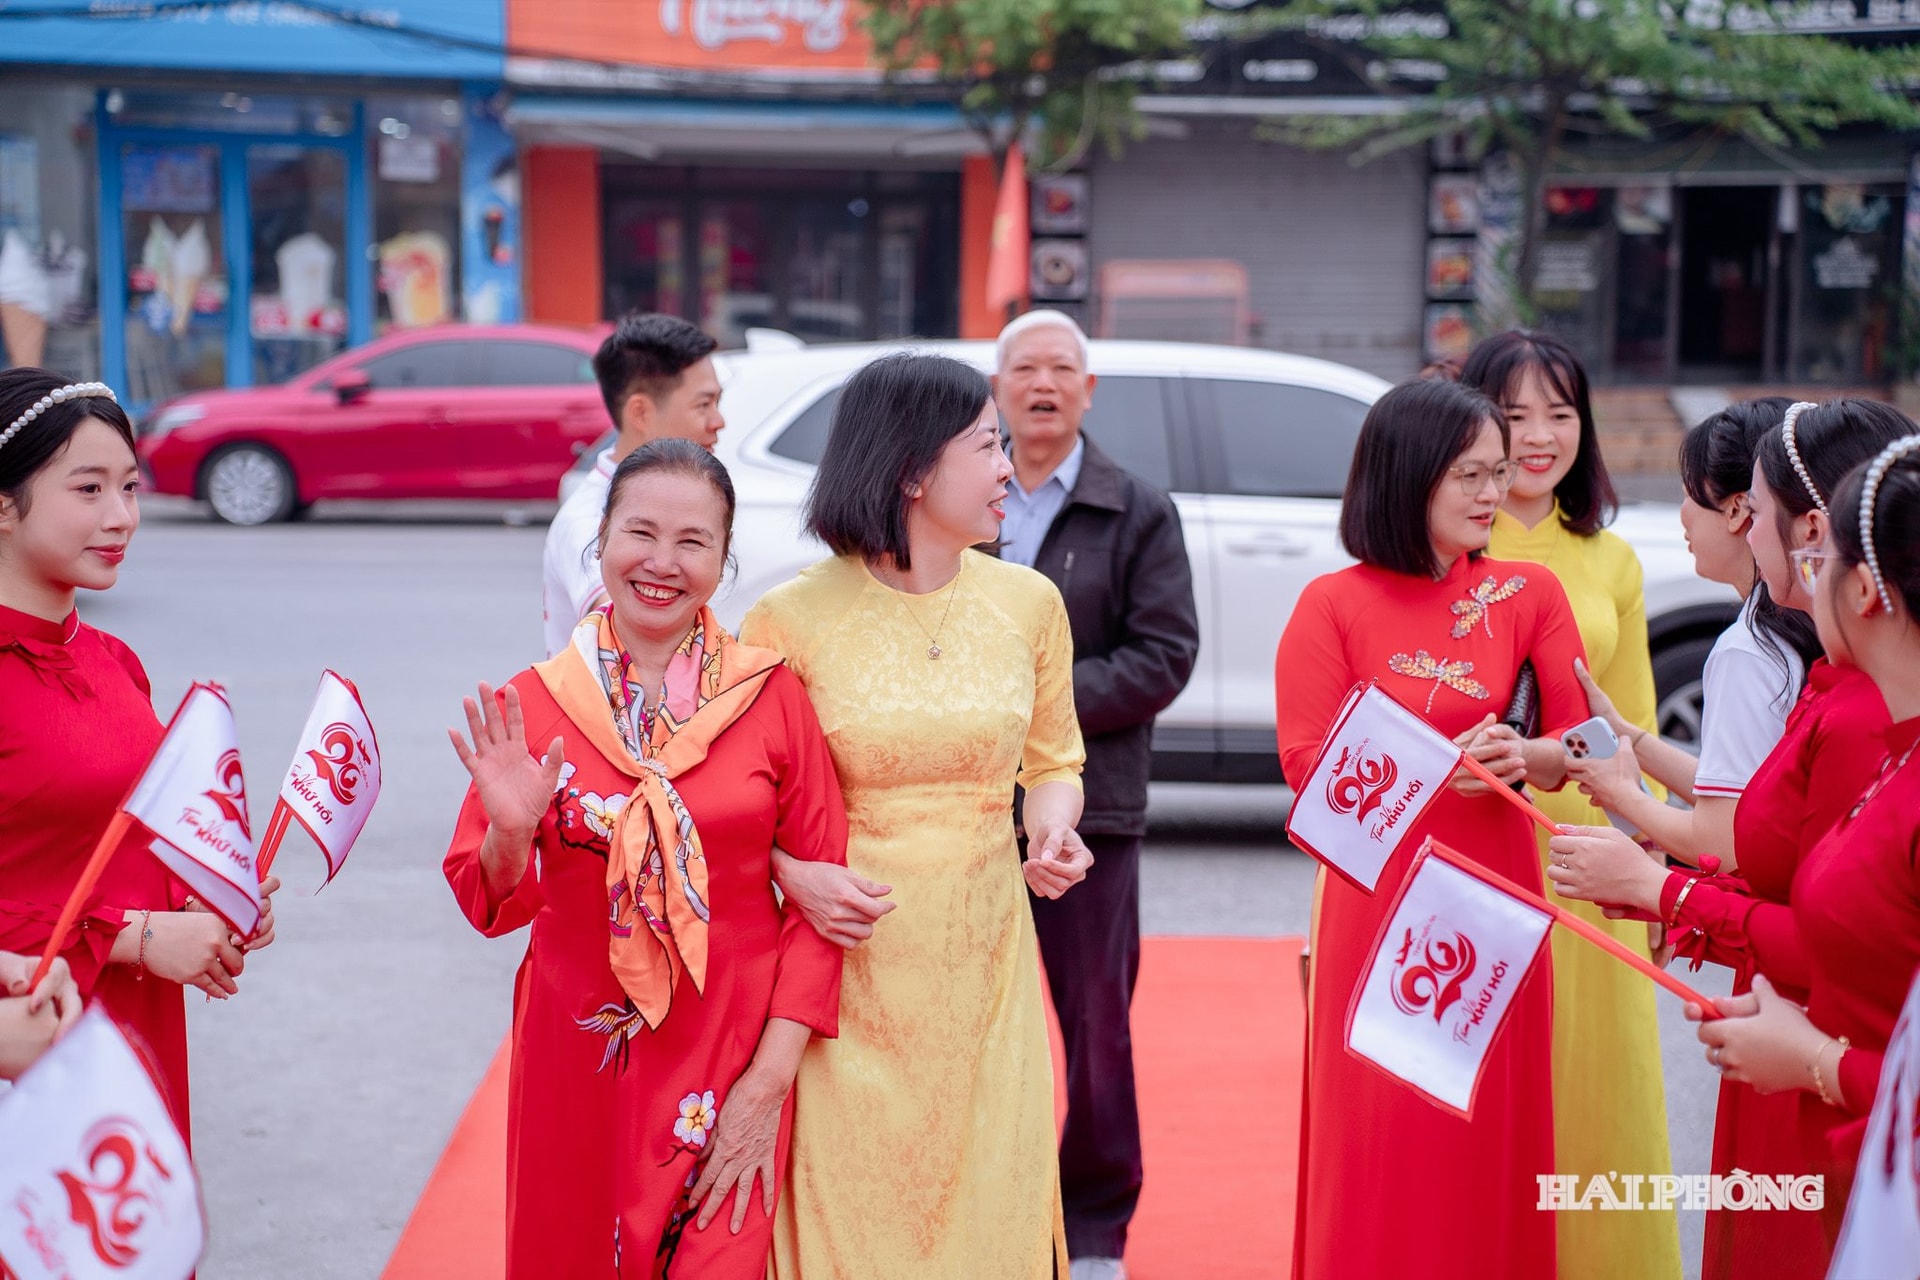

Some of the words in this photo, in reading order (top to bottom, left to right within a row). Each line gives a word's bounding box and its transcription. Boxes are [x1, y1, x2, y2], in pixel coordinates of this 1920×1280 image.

[290, 777, 319, 802] KHỨ
[312, 801, 333, 825] HỒI
[1384, 799, 1407, 829] KHỨ
[1402, 779, 1424, 803] HỒI
[193, 827, 232, 854] KHỨ
[1469, 988, 1493, 1026] KHỨ
[1487, 960, 1510, 990] HỒI
